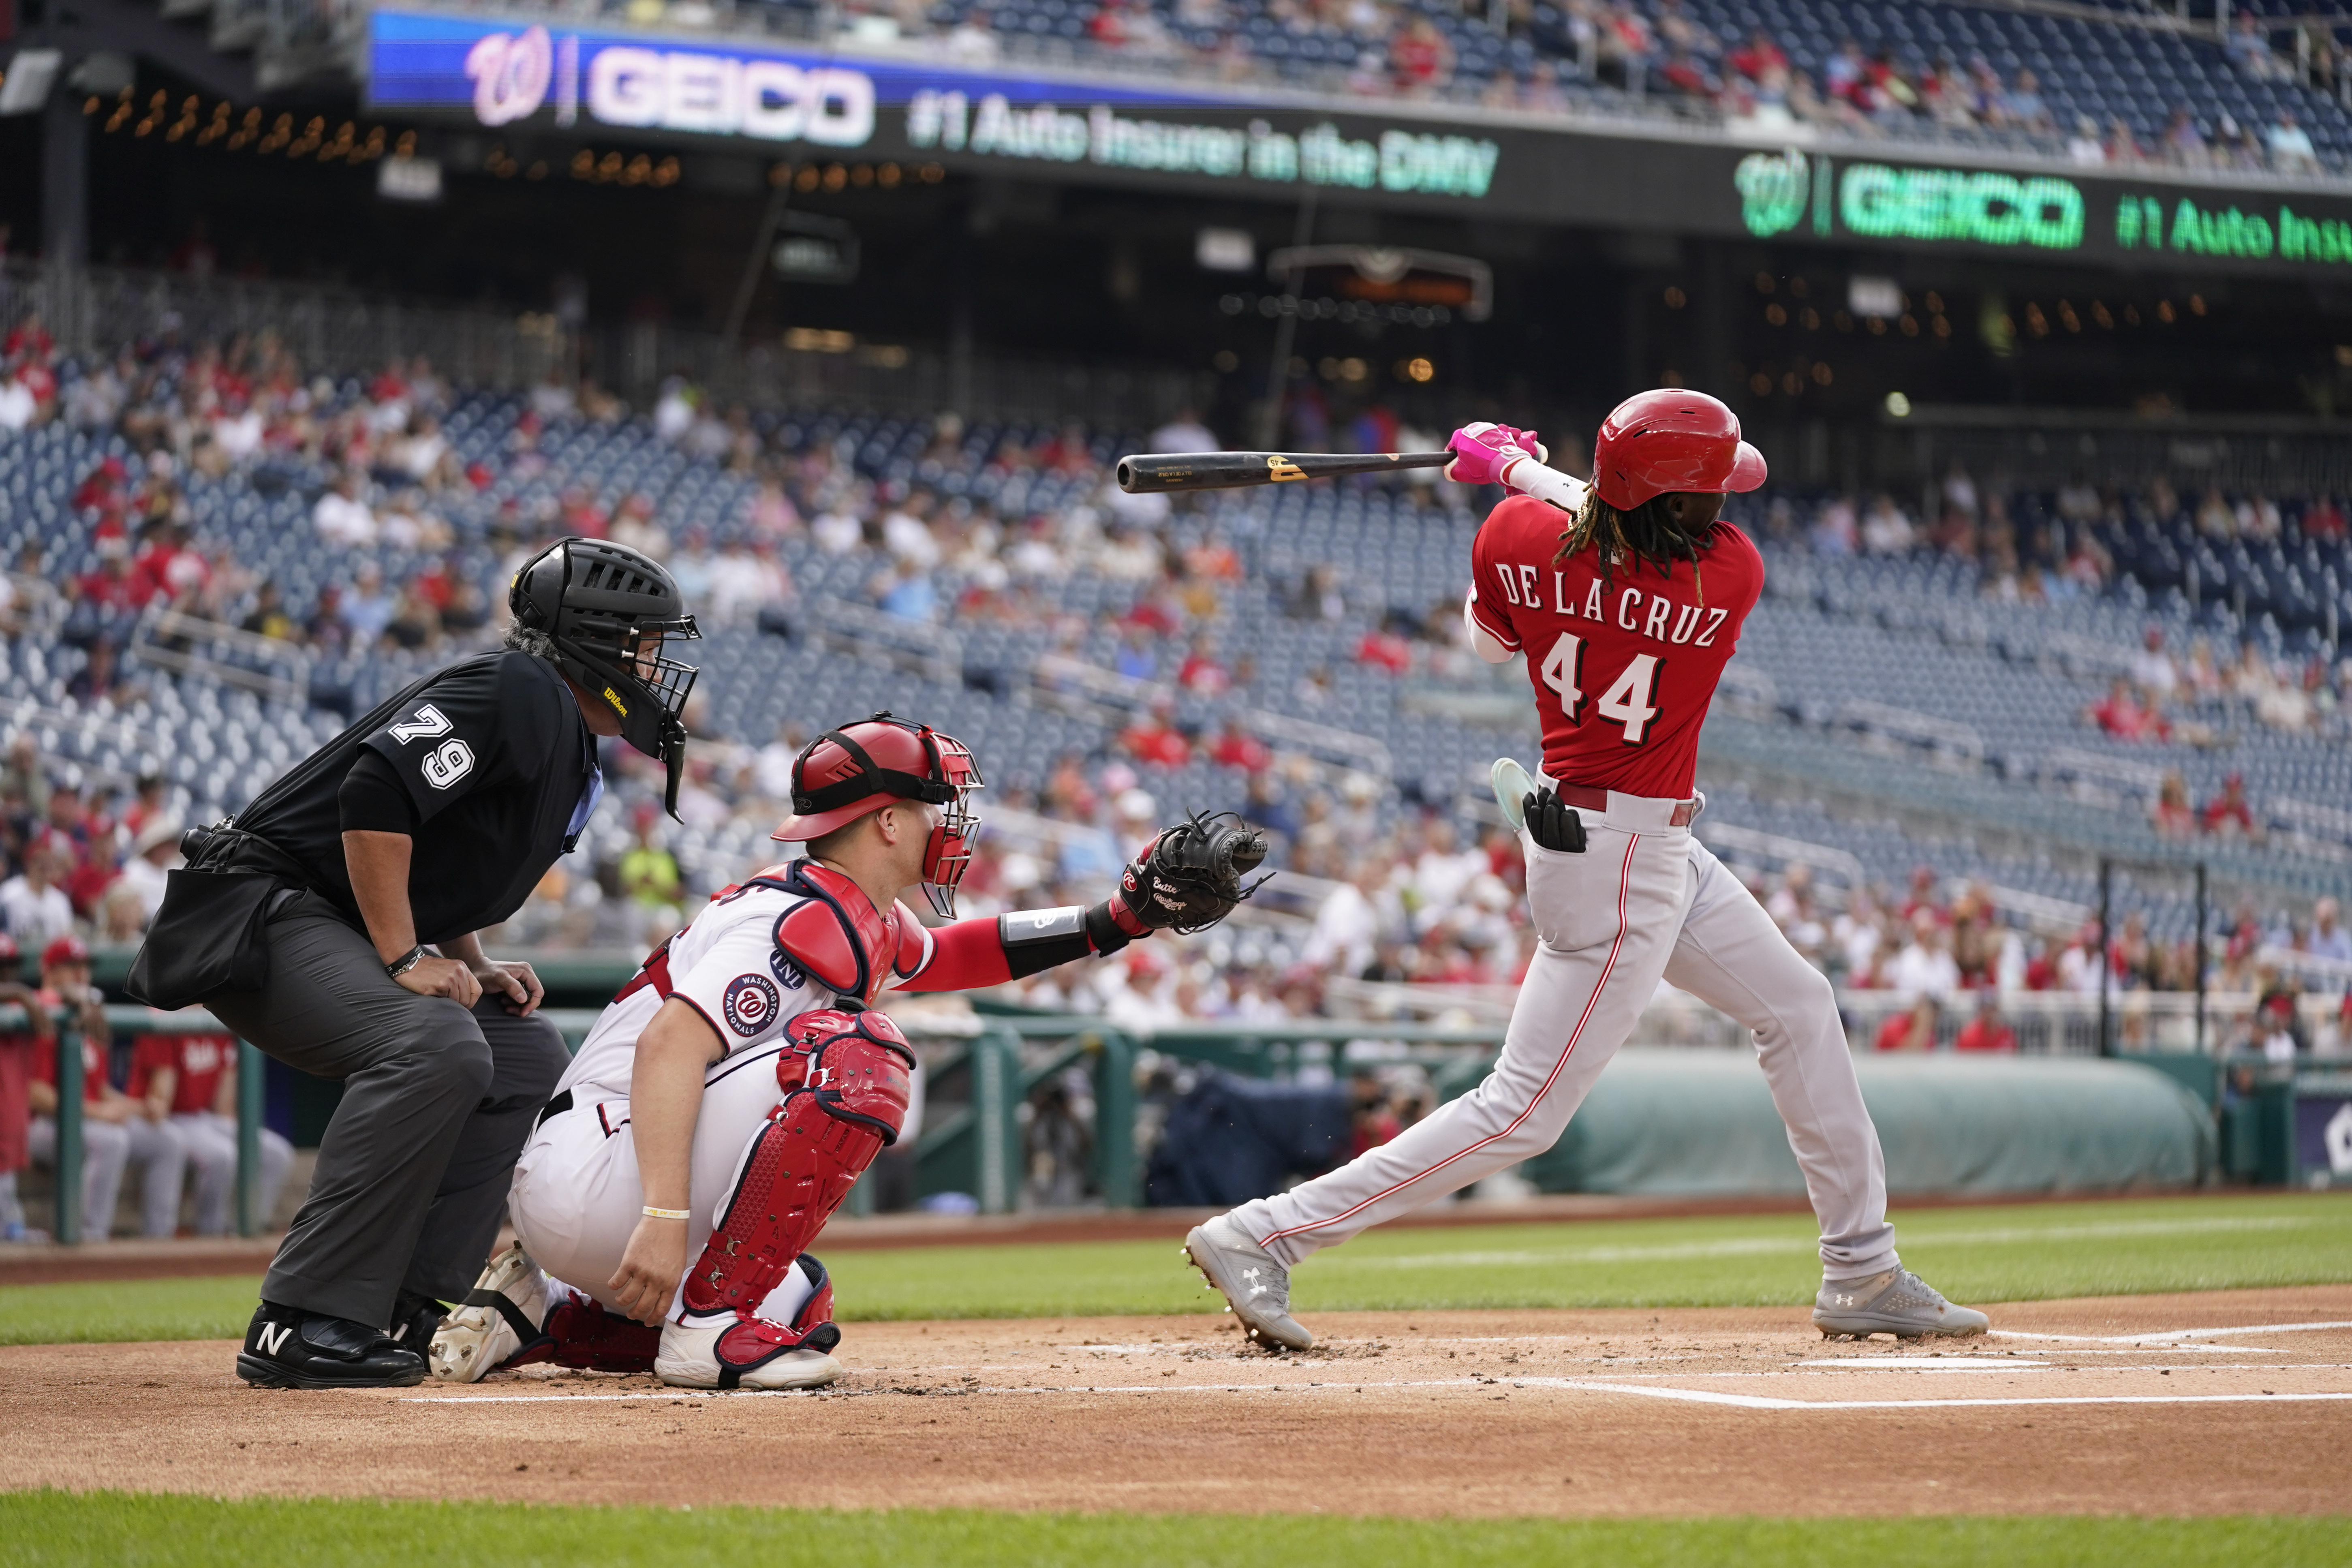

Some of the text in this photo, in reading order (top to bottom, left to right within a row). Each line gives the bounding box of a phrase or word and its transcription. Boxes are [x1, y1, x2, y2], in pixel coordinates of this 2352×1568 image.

[589, 46, 876, 146] GEICO
[907, 88, 1499, 197] #1 Auto Insurer in the DMV
[1840, 163, 2084, 250] GEICO
[2117, 194, 2162, 250] #1
[2170, 197, 2274, 259] Auto
[1495, 563, 1729, 648] DE LA CRUZ
[604, 687, 627, 717] Wilson
[1540, 631, 1667, 746] 44
[388, 703, 476, 790] 79
[1153, 892, 1187, 911] Rawlings
[726, 993, 755, 1034] NATIONALS
[742, 976, 777, 1022] WASHINGTON
[256, 1321, 293, 1356] N
